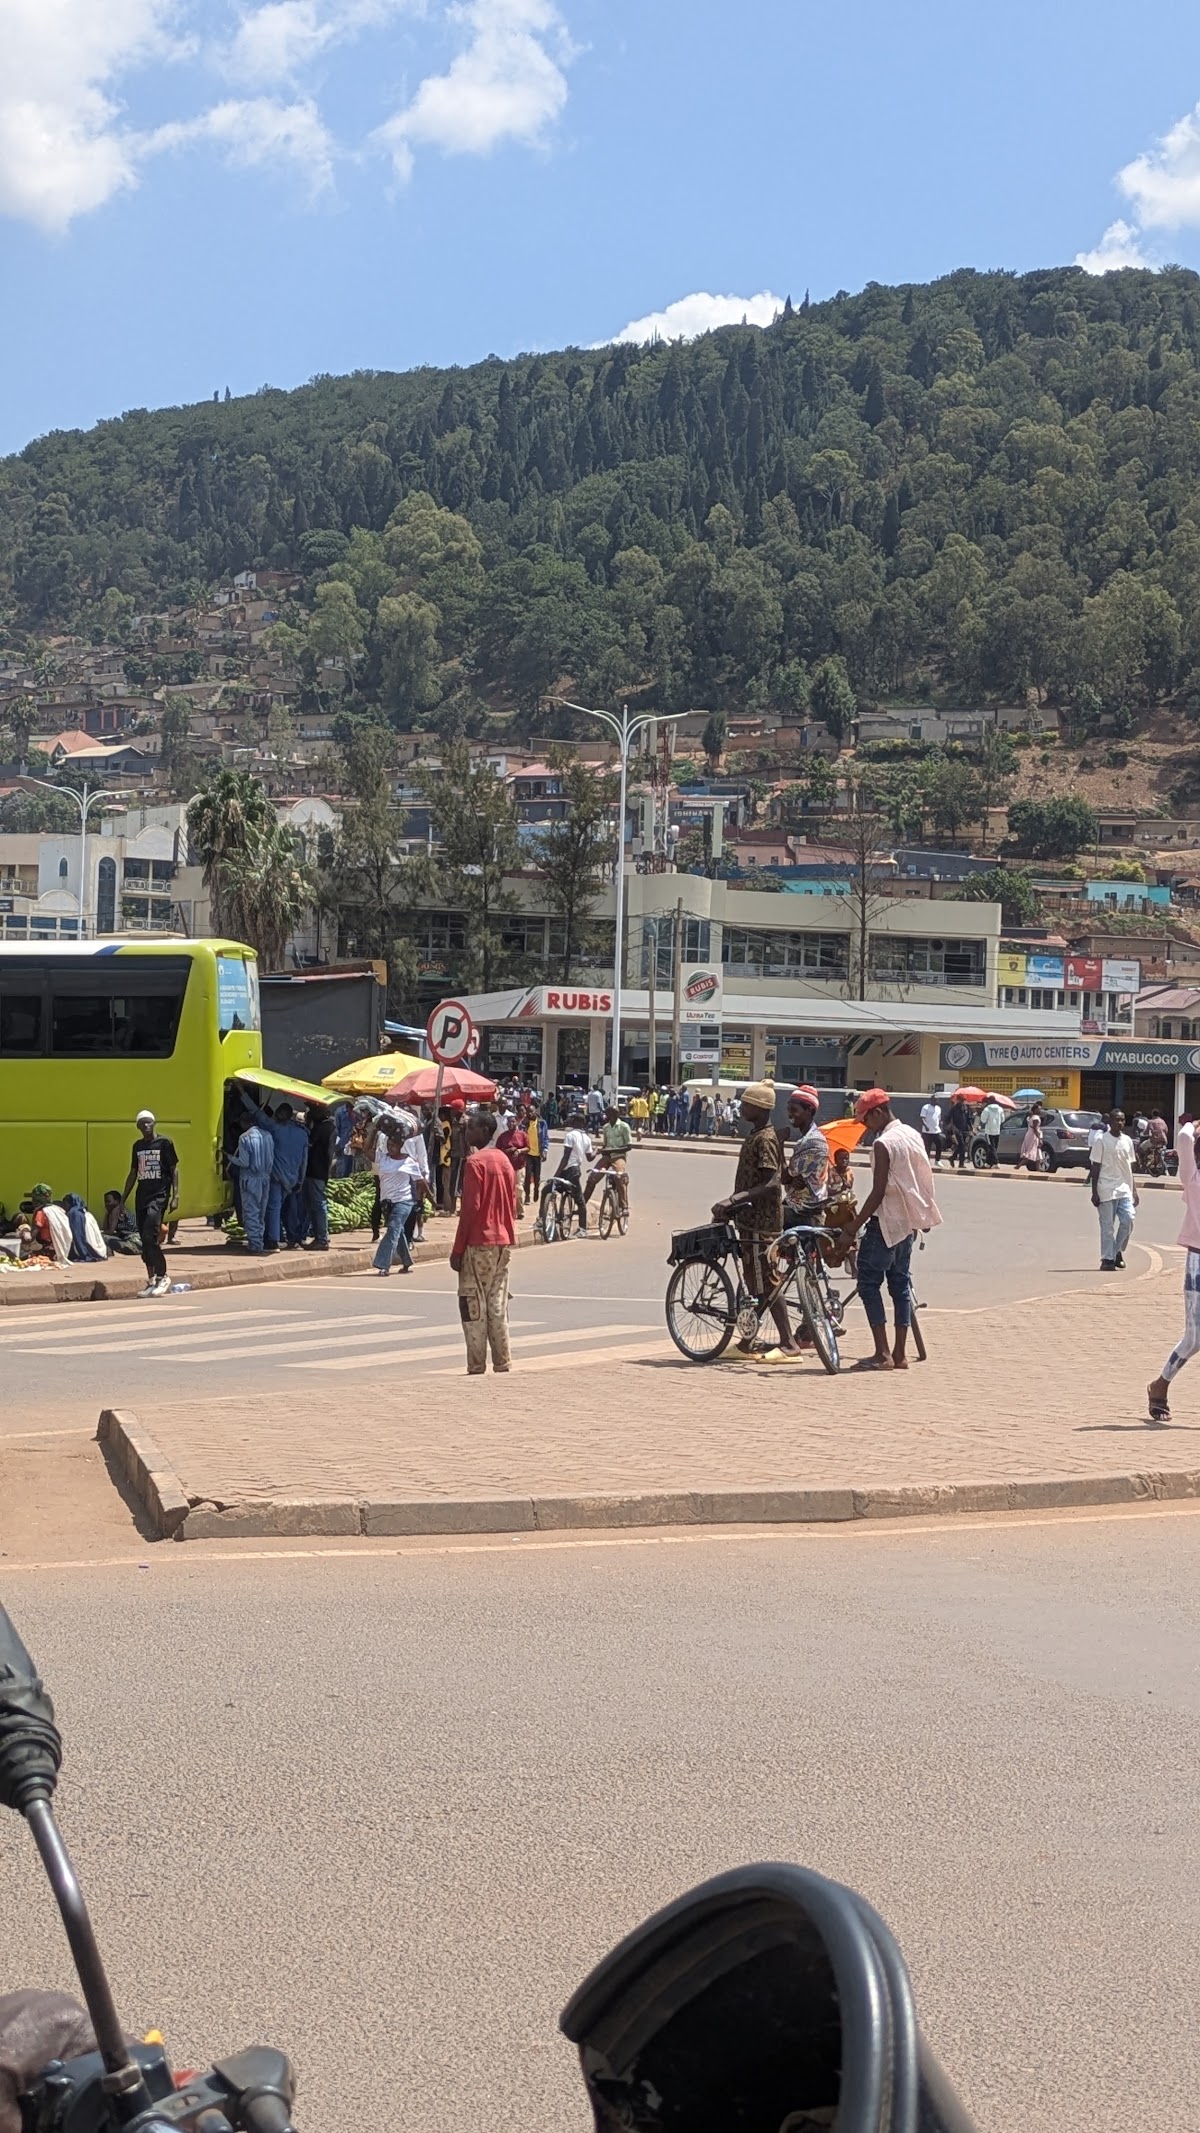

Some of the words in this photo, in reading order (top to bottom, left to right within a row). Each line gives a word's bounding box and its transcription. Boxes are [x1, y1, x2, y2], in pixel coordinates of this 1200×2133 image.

[440, 1015, 462, 1049] P
[989, 1047, 1009, 1059] TYRE
[1020, 1047, 1042, 1059] AUTO
[1044, 1047, 1090, 1060] CENTERS
[1105, 1051, 1179, 1066] NYABUGOGO
